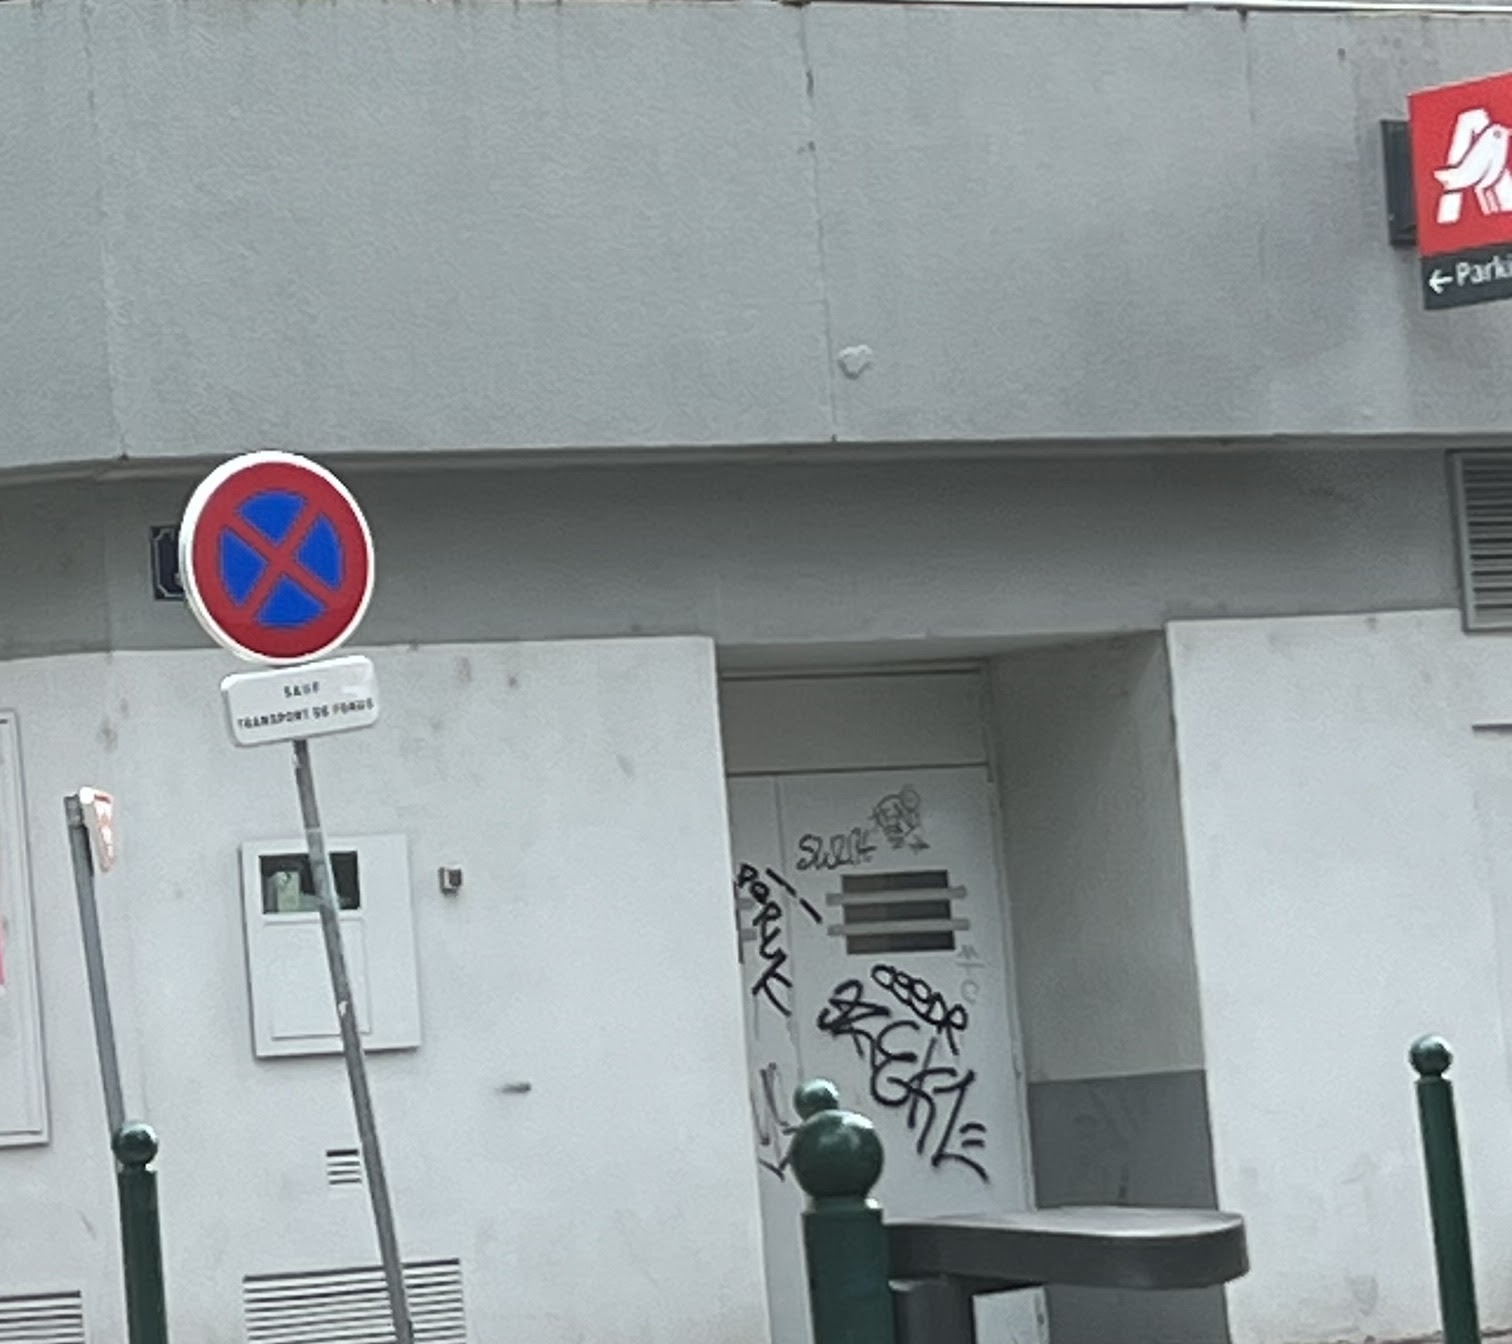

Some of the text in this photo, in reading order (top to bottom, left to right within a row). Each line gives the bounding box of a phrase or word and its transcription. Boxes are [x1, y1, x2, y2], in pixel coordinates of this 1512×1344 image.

[238, 698, 374, 729] TRANSPORT DE FONDS
